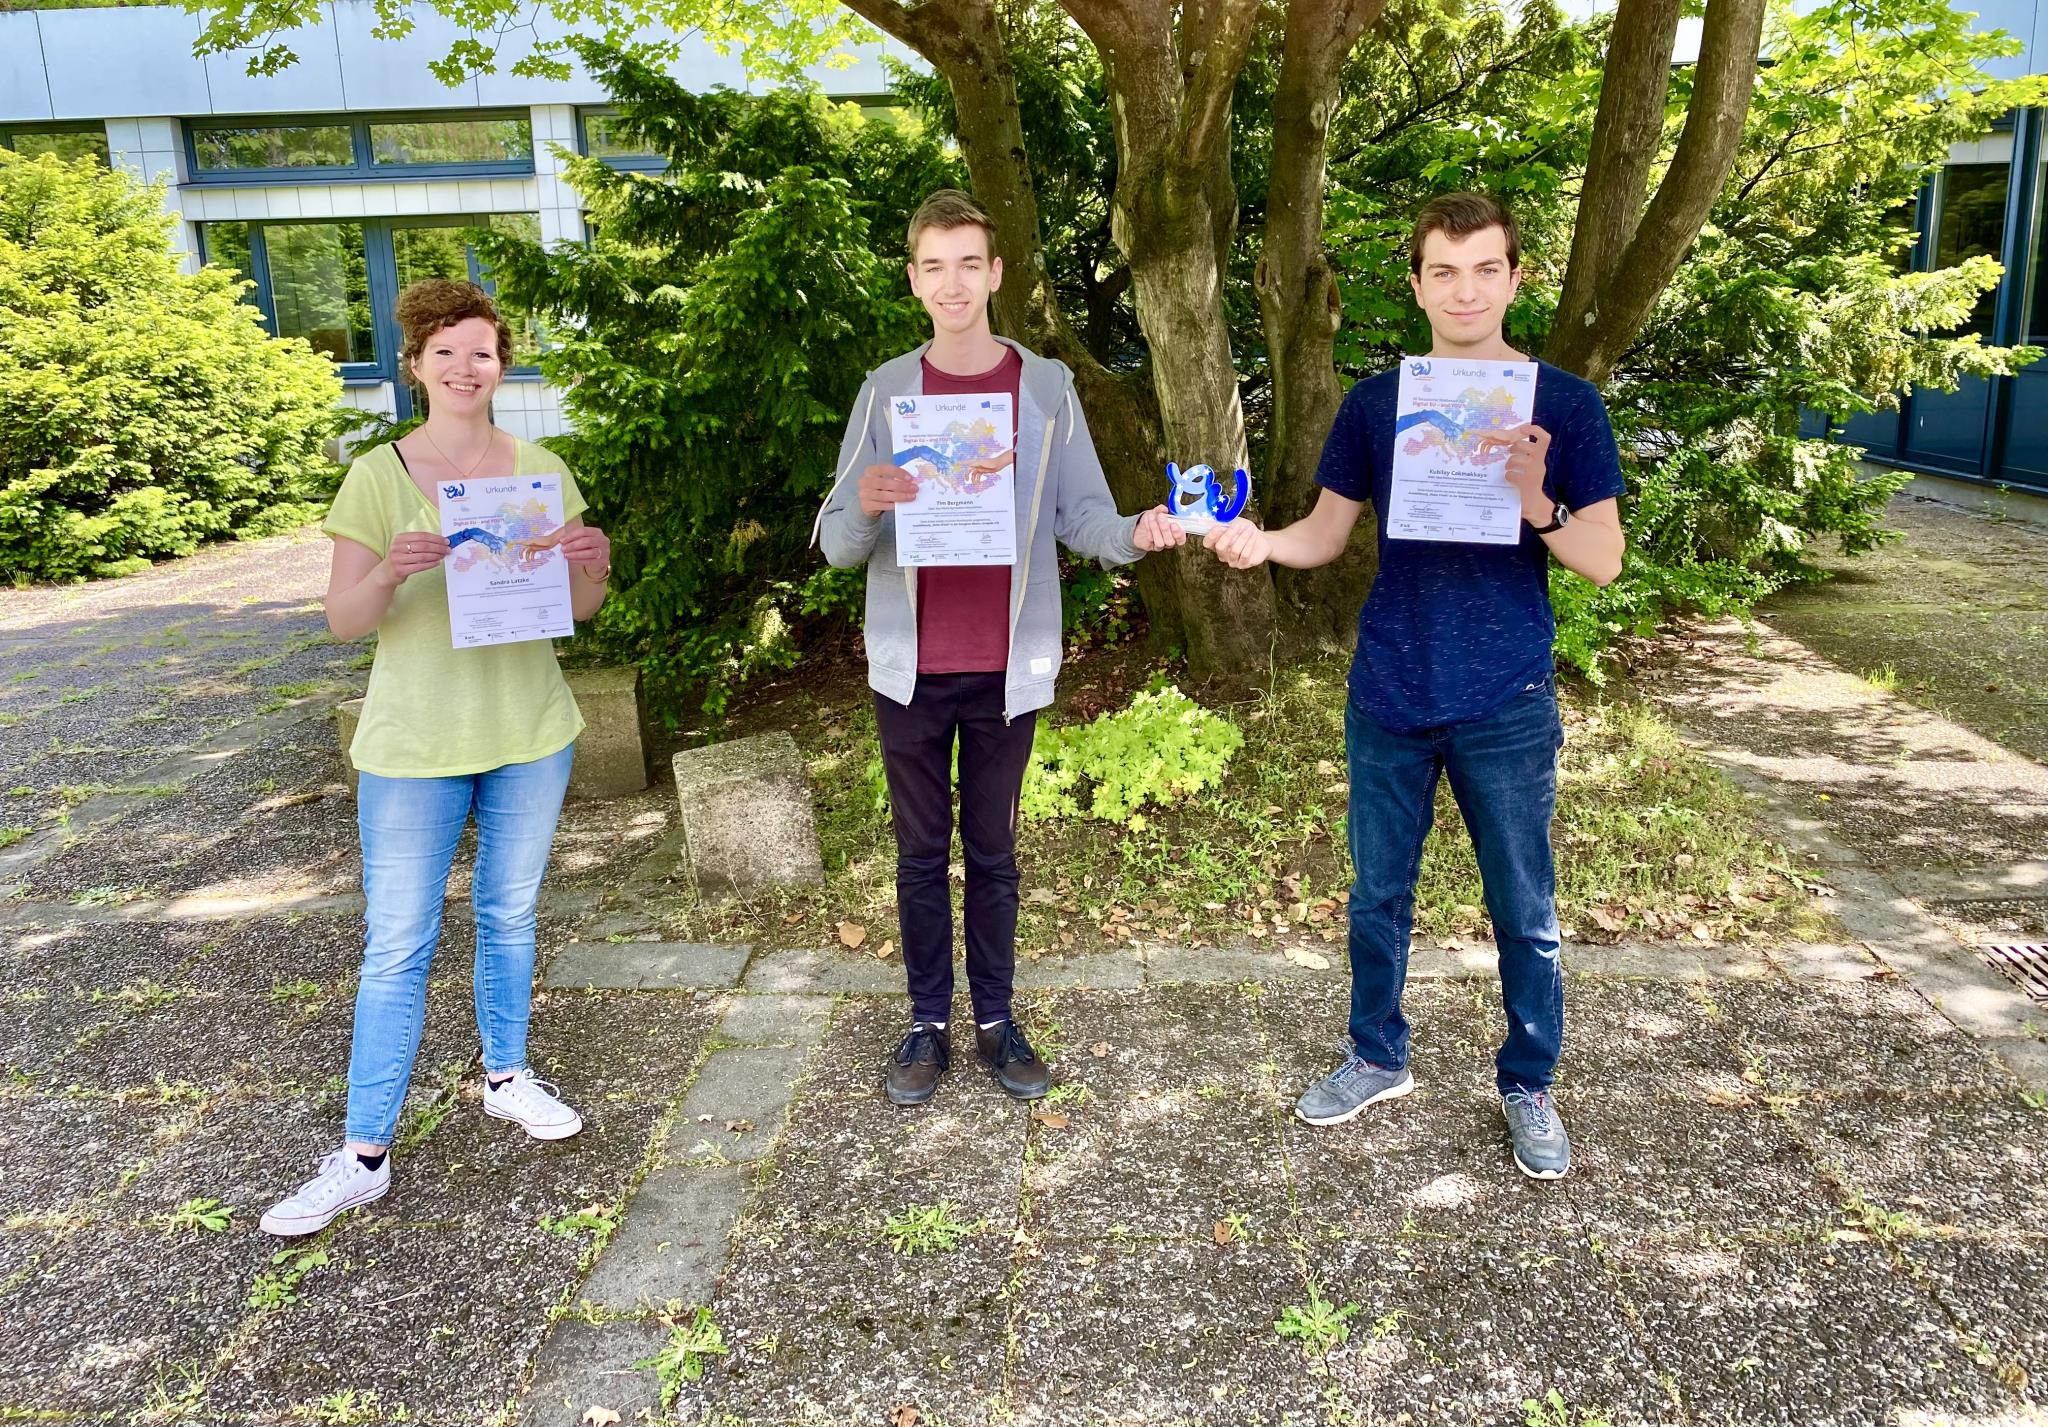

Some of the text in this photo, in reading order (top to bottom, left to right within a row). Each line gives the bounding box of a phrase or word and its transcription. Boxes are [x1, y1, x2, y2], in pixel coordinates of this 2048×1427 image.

[1452, 368, 1487, 378] Urkunde
[935, 403, 967, 412] Urkunde
[485, 485, 518, 494] Urkunde
